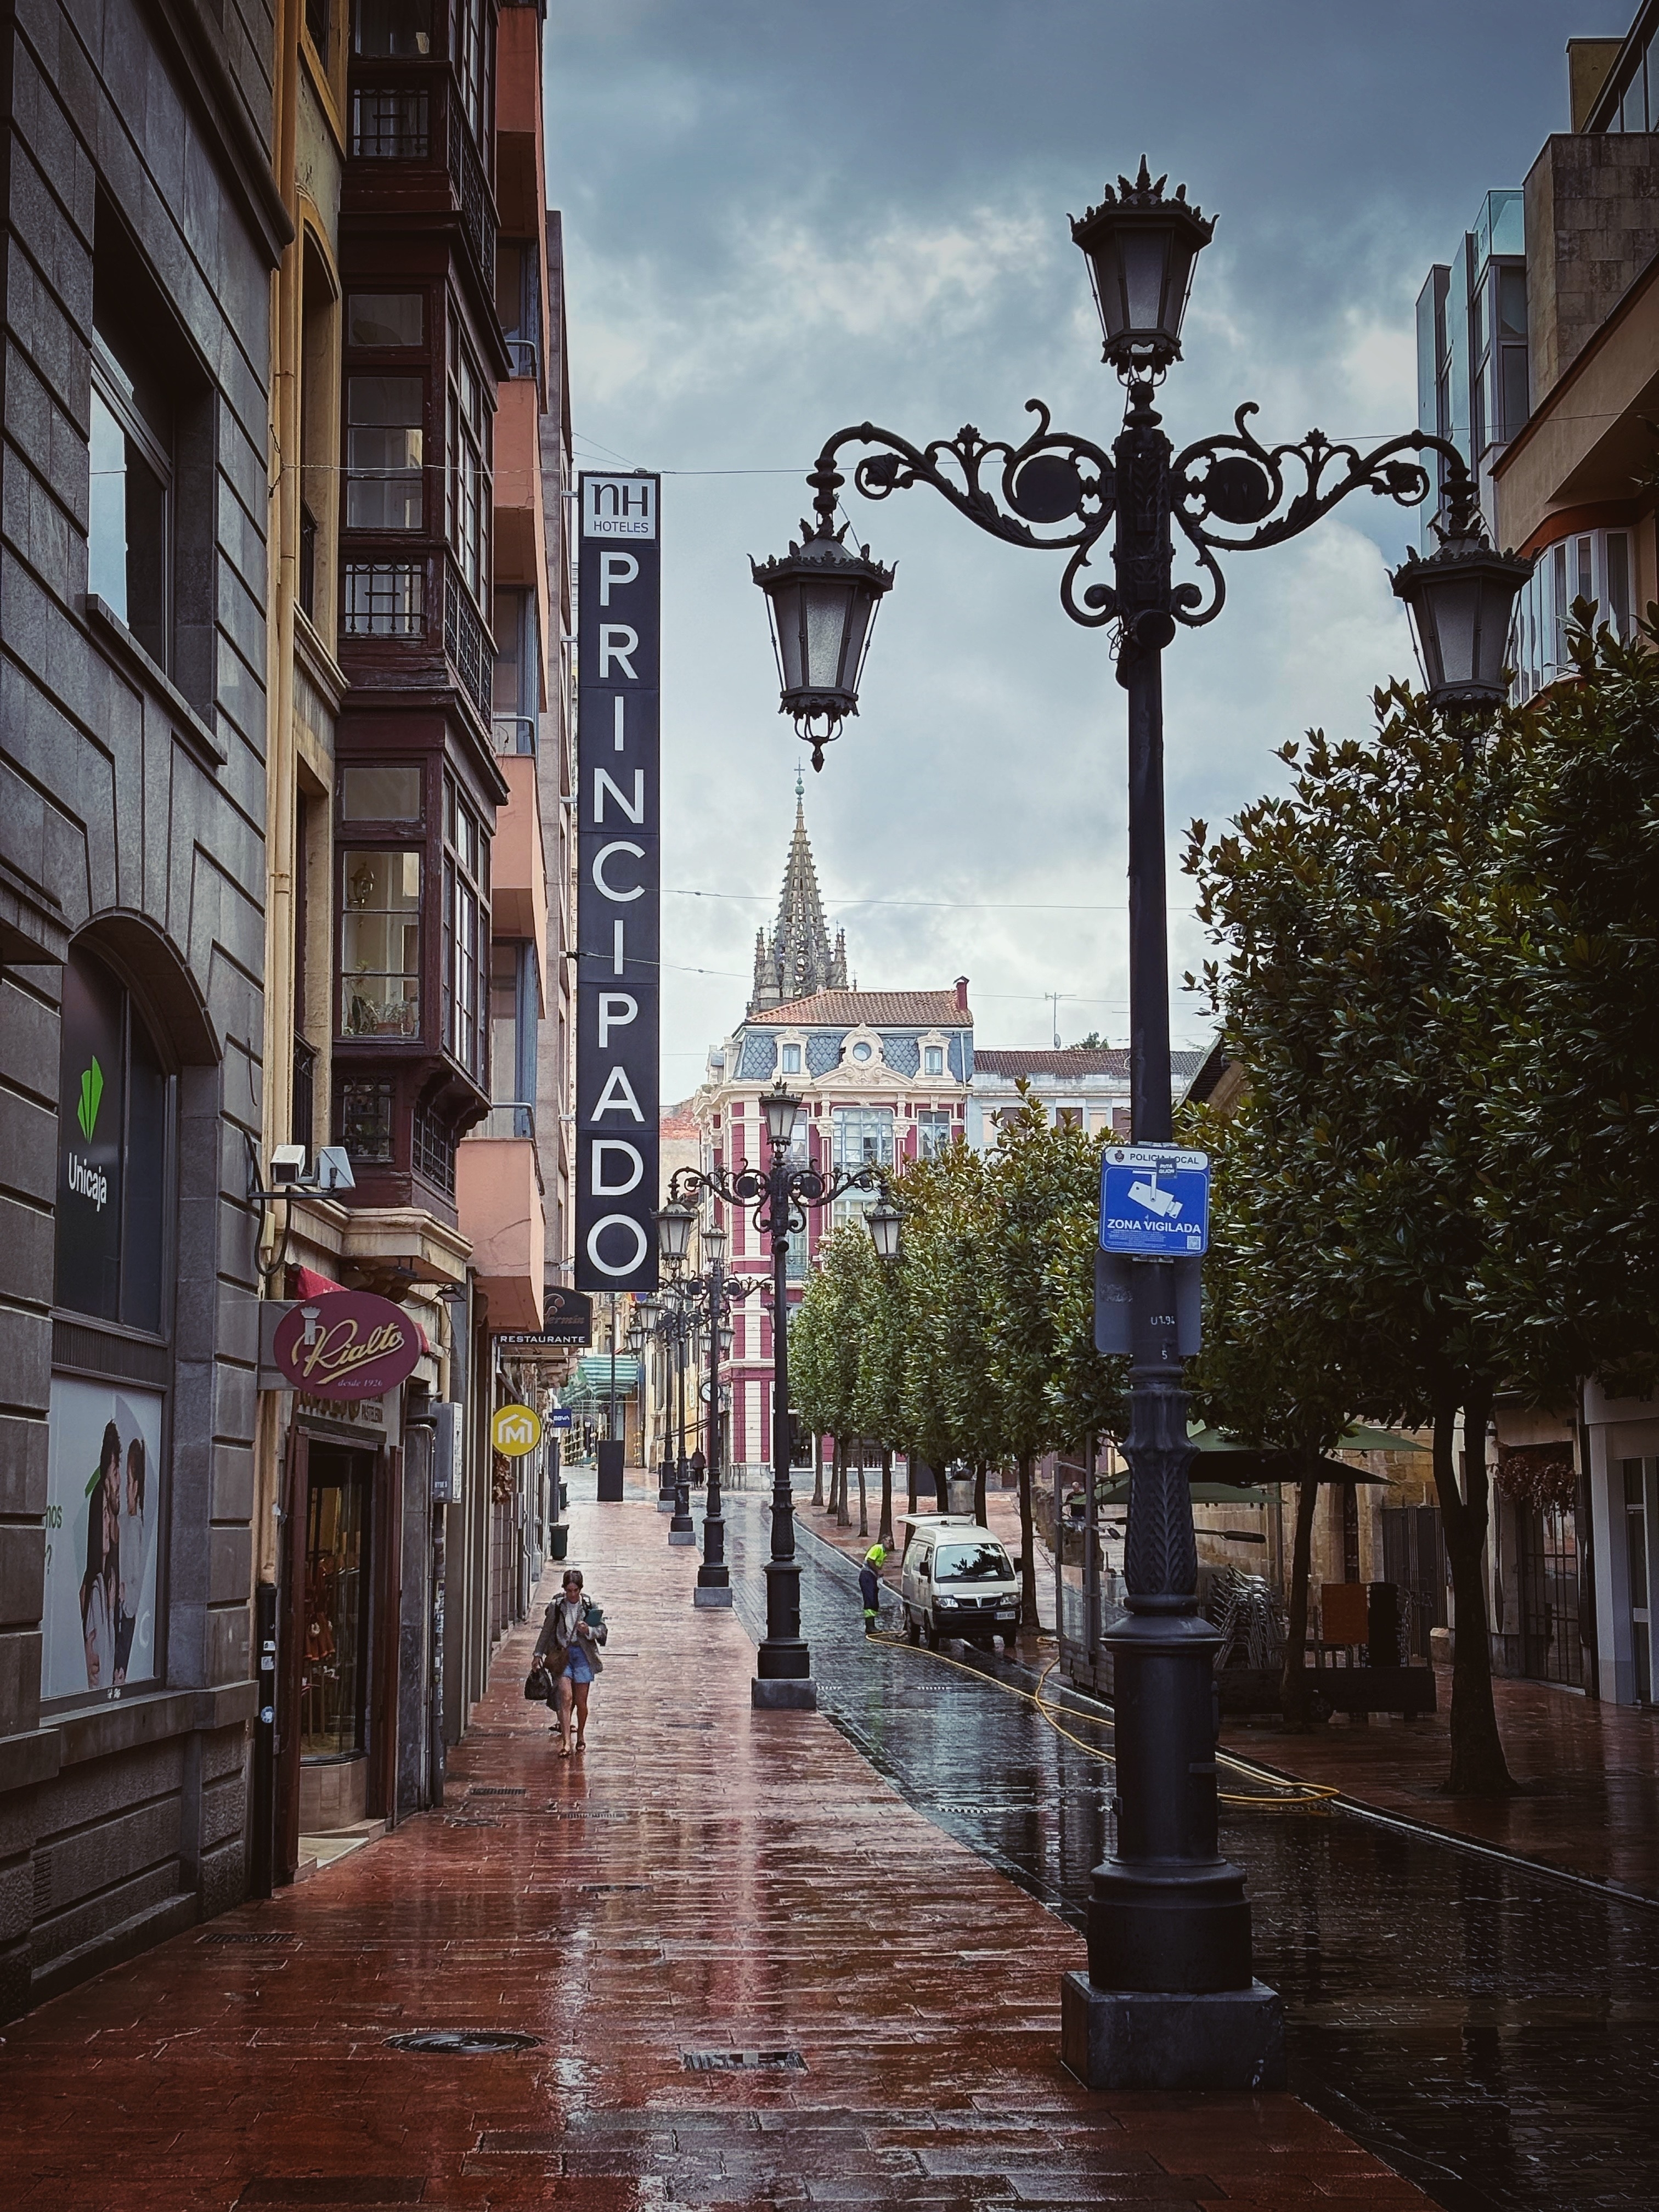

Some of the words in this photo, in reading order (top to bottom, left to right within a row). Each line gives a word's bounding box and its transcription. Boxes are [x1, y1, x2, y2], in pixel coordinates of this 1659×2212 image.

[594, 521, 649, 533] HOTELES
[586, 551, 648, 1277] PRINCIPADO
[69, 1152, 107, 1212] Unicaja
[1107, 1218, 1142, 1231] ZONA
[1144, 1221, 1202, 1234] VIGILADA
[500, 1335, 585, 1344] RESTAURANTE
[291, 1318, 405, 1379] Rialto
[337, 1379, 361, 1387] desde
